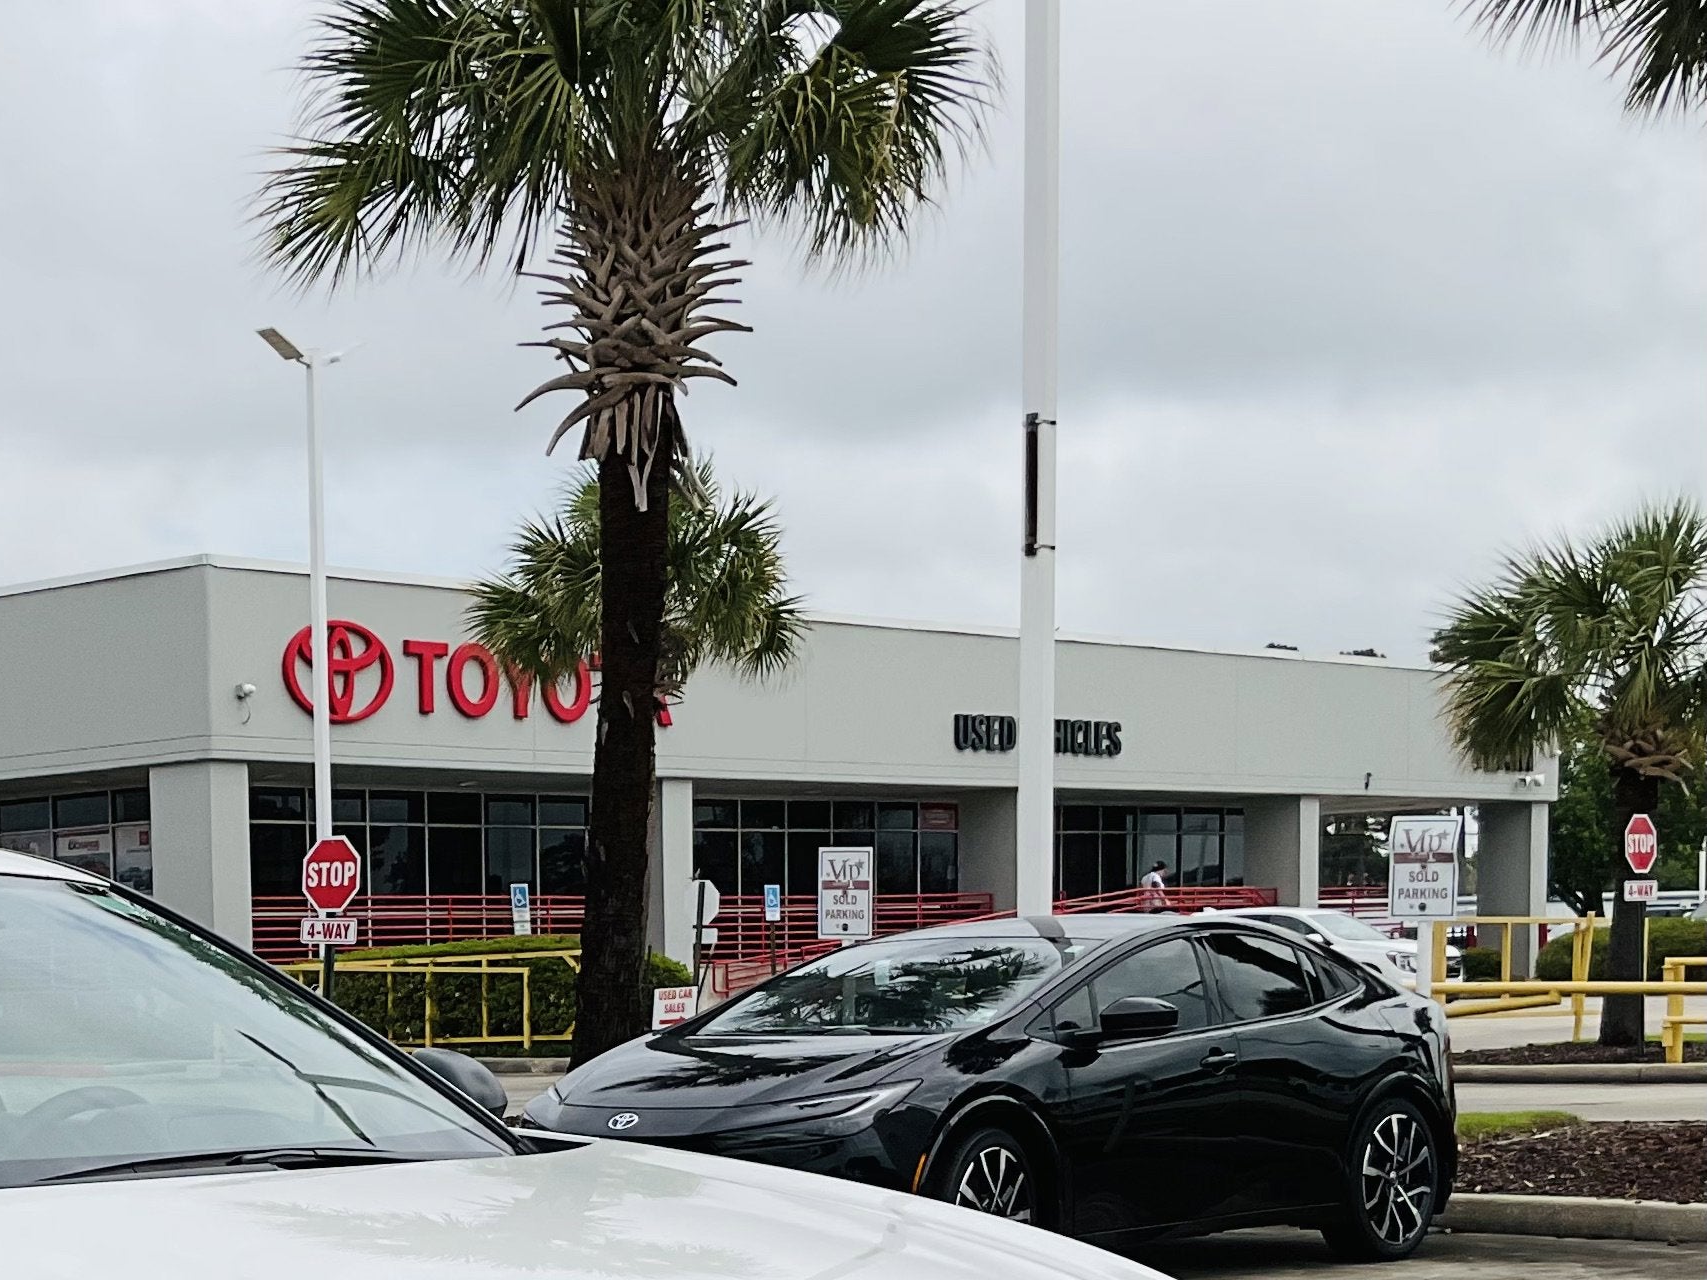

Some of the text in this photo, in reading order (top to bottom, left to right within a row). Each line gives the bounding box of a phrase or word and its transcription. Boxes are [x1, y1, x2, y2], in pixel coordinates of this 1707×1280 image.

[403, 639, 673, 727] TOYO
[954, 714, 1122, 756] USED HICLES
[1628, 833, 1654, 854] STOP
[307, 861, 356, 888] STOP
[1408, 870, 1439, 883] SOLD
[1397, 887, 1448, 900] PARKING
[1628, 884, 1653, 897] 4-WAY
[833, 894, 858, 906] SOLD
[825, 909, 865, 920] PARKING
[307, 922, 350, 940] 4-WAY
[659, 989, 692, 1000] USED CAR
[664, 1002, 685, 1014] SALES
